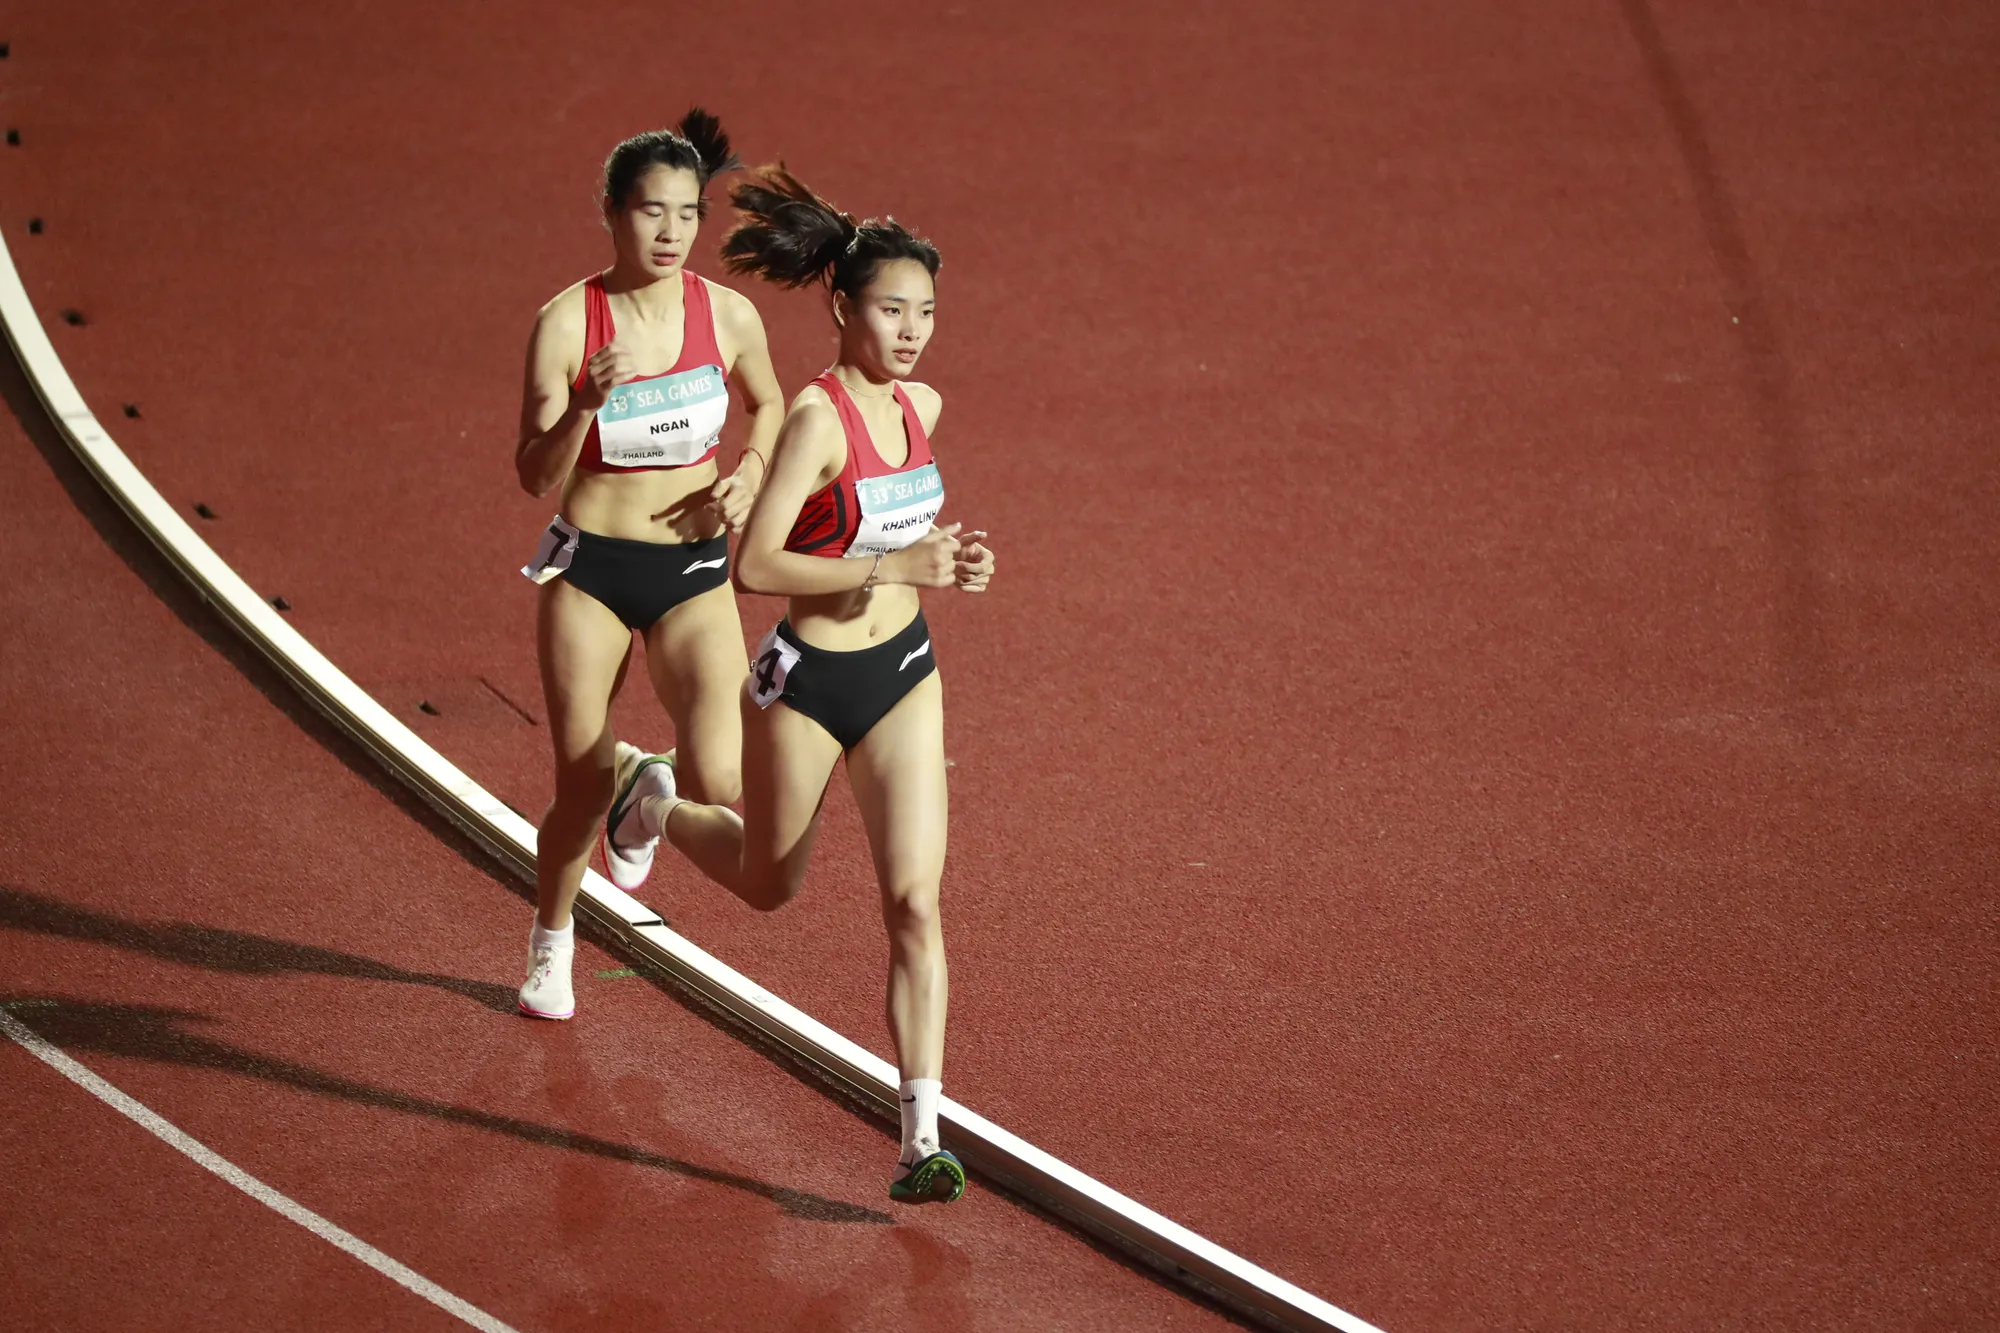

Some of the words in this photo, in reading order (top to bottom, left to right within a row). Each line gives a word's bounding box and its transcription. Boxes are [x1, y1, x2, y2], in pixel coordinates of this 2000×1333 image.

[637, 388, 665, 408] SEA
[668, 375, 712, 400] GAMES
[650, 418, 690, 435] NGAN
[623, 450, 664, 460] THAILAND
[894, 482, 913, 501] SEA
[915, 474, 940, 494] GAME
[881, 515, 917, 532] KHANH
[919, 508, 937, 524] LINH
[537, 524, 570, 573] 7
[756, 647, 783, 697] 4
